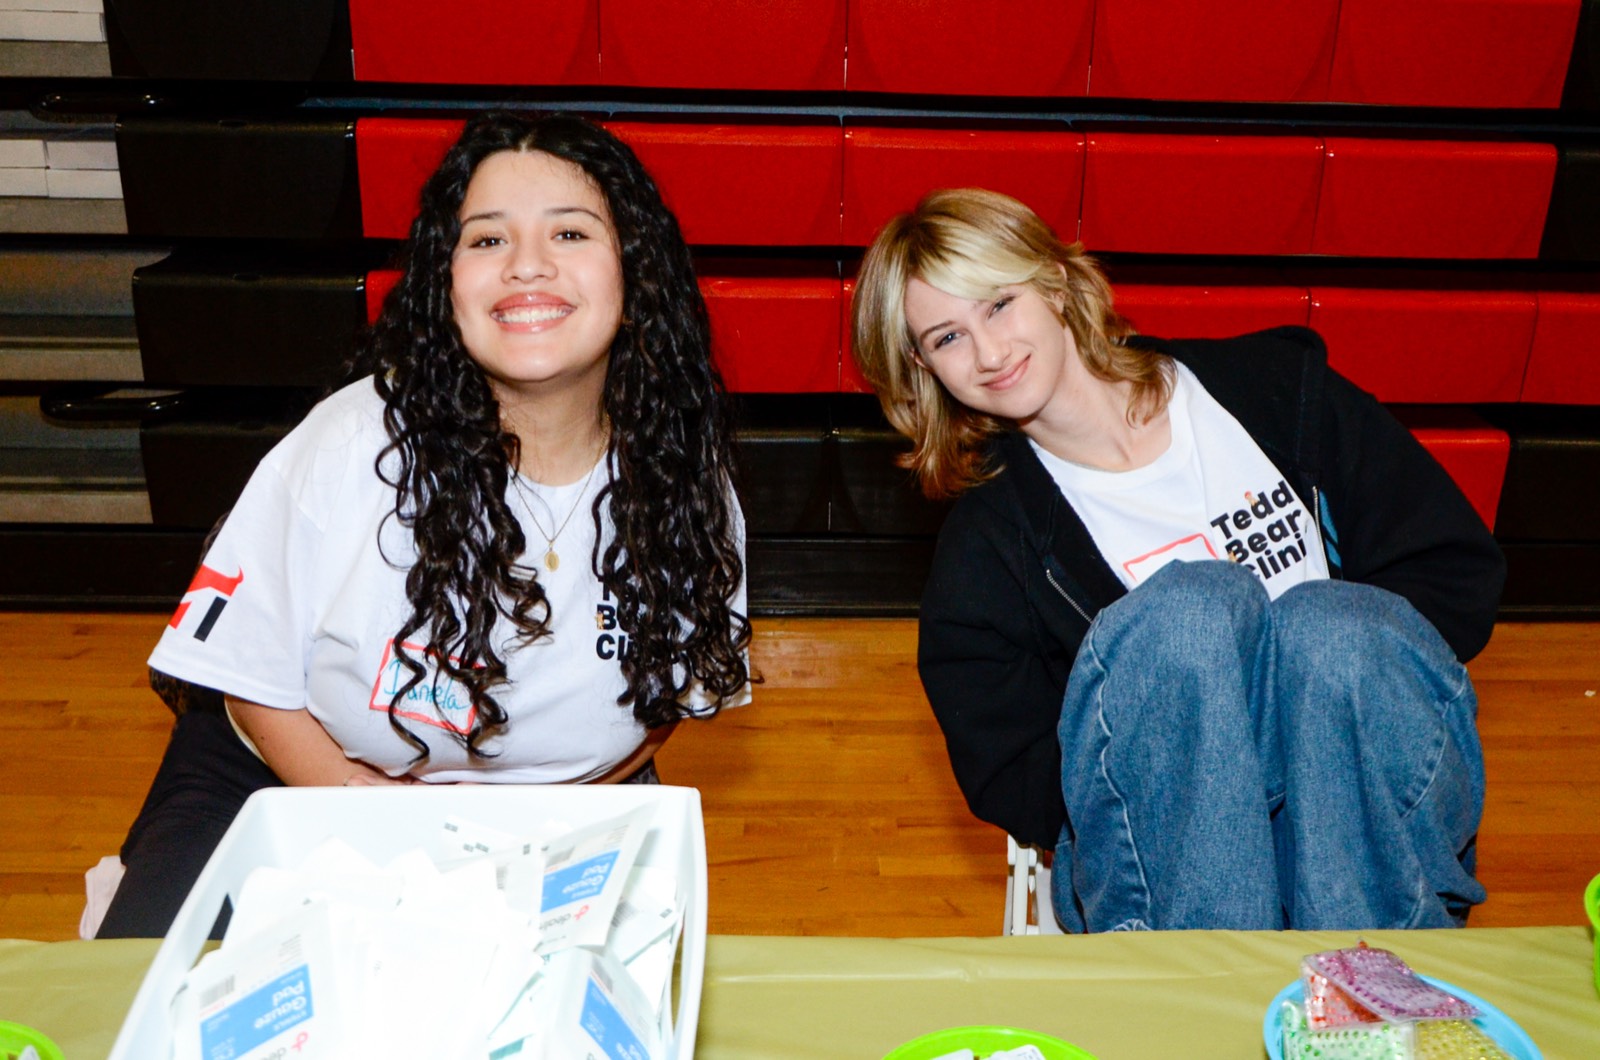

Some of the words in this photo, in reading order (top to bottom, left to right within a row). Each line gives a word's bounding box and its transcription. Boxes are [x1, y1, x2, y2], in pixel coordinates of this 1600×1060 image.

[1210, 480, 1295, 540] Tedd
[1224, 508, 1302, 563] Bear
[1244, 532, 1307, 580] lini
[253, 996, 307, 1029] Gauze
[272, 980, 305, 1006] Pad
